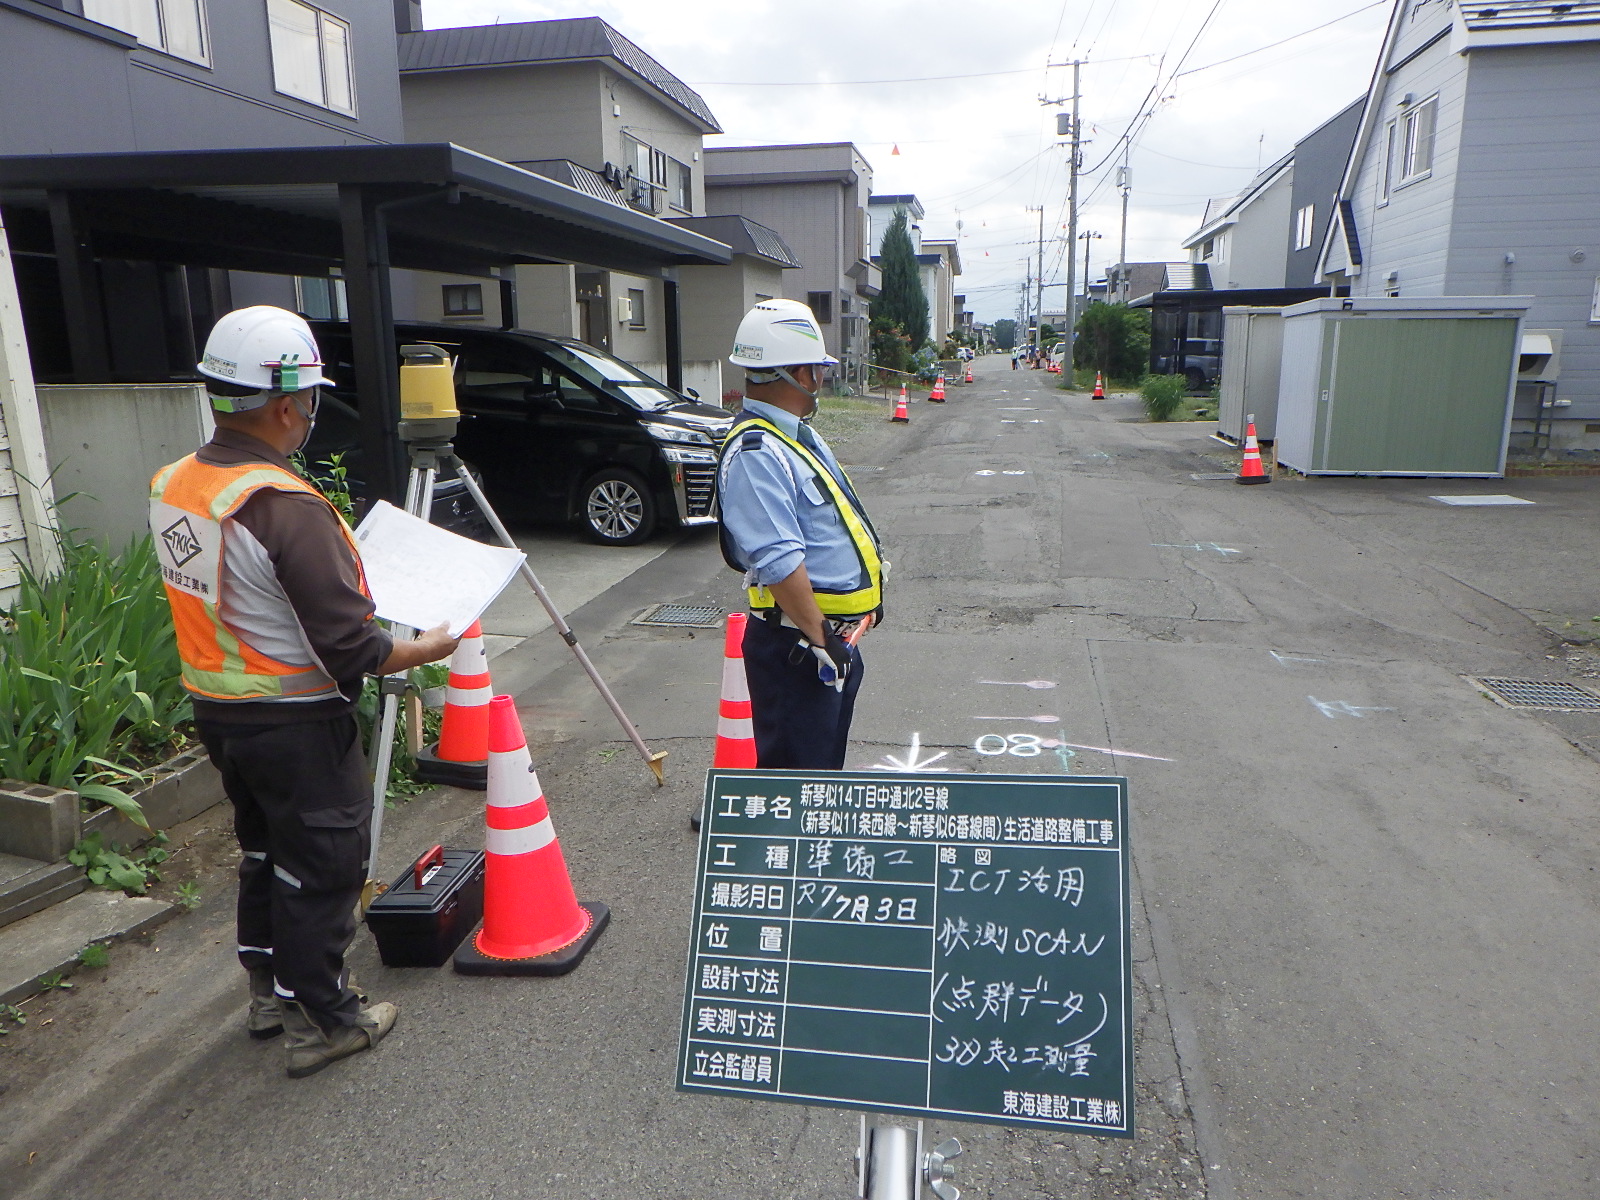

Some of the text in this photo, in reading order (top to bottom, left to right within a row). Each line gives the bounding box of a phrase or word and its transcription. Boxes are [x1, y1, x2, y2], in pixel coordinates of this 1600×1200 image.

[171, 530, 192, 555] TKK
[718, 795, 792, 820] 工事名
[800, 784, 949, 810] 新琴似14丁目中通北2号線
[710, 882, 784, 910] 撮影月日
[701, 964, 780, 995] 設計寸法
[696, 1006, 776, 1039] 実測寸法
[692, 1050, 772, 1084] 立会監督員
